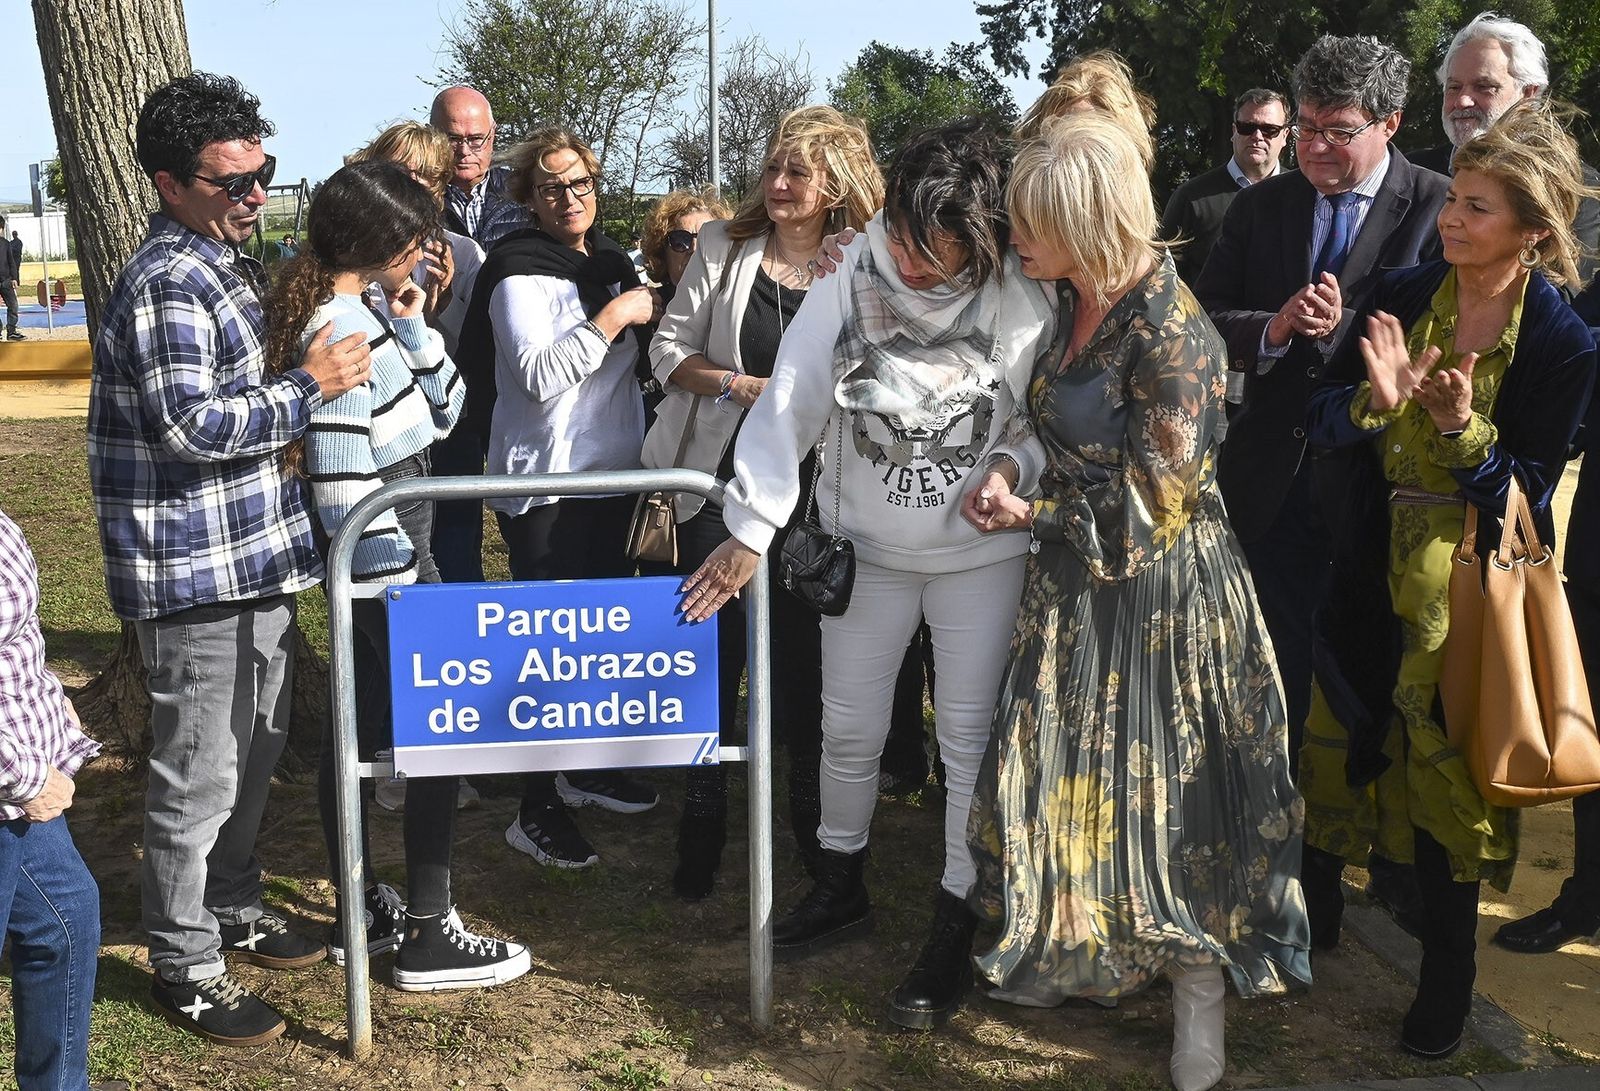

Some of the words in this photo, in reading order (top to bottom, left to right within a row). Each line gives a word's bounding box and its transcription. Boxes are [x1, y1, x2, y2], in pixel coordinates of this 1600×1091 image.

[872, 445, 977, 493] TIGERS
[886, 491, 946, 508] EST.1987
[478, 603, 630, 642] Parque
[413, 654, 492, 687] Los
[518, 648, 696, 682] Abrazos
[429, 699, 480, 733] de
[509, 691, 683, 729] Candela
